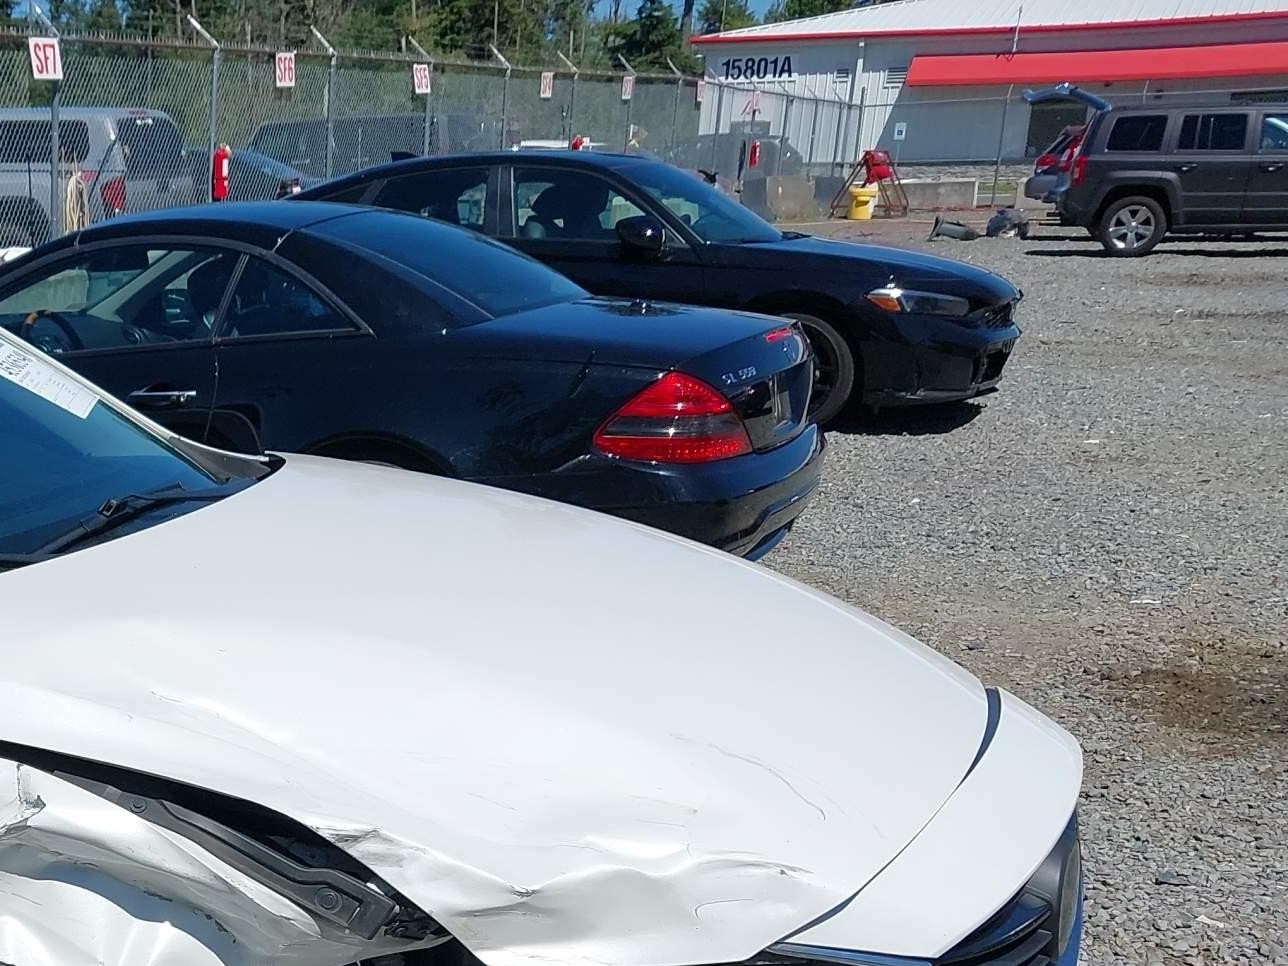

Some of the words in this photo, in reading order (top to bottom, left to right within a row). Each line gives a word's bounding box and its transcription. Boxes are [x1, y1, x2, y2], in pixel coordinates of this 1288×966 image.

[33, 43, 56, 75] SF7
[277, 56, 294, 82] SF6
[721, 55, 793, 81] 15801A
[414, 66, 429, 89] SF5
[721, 372, 738, 385] SL
